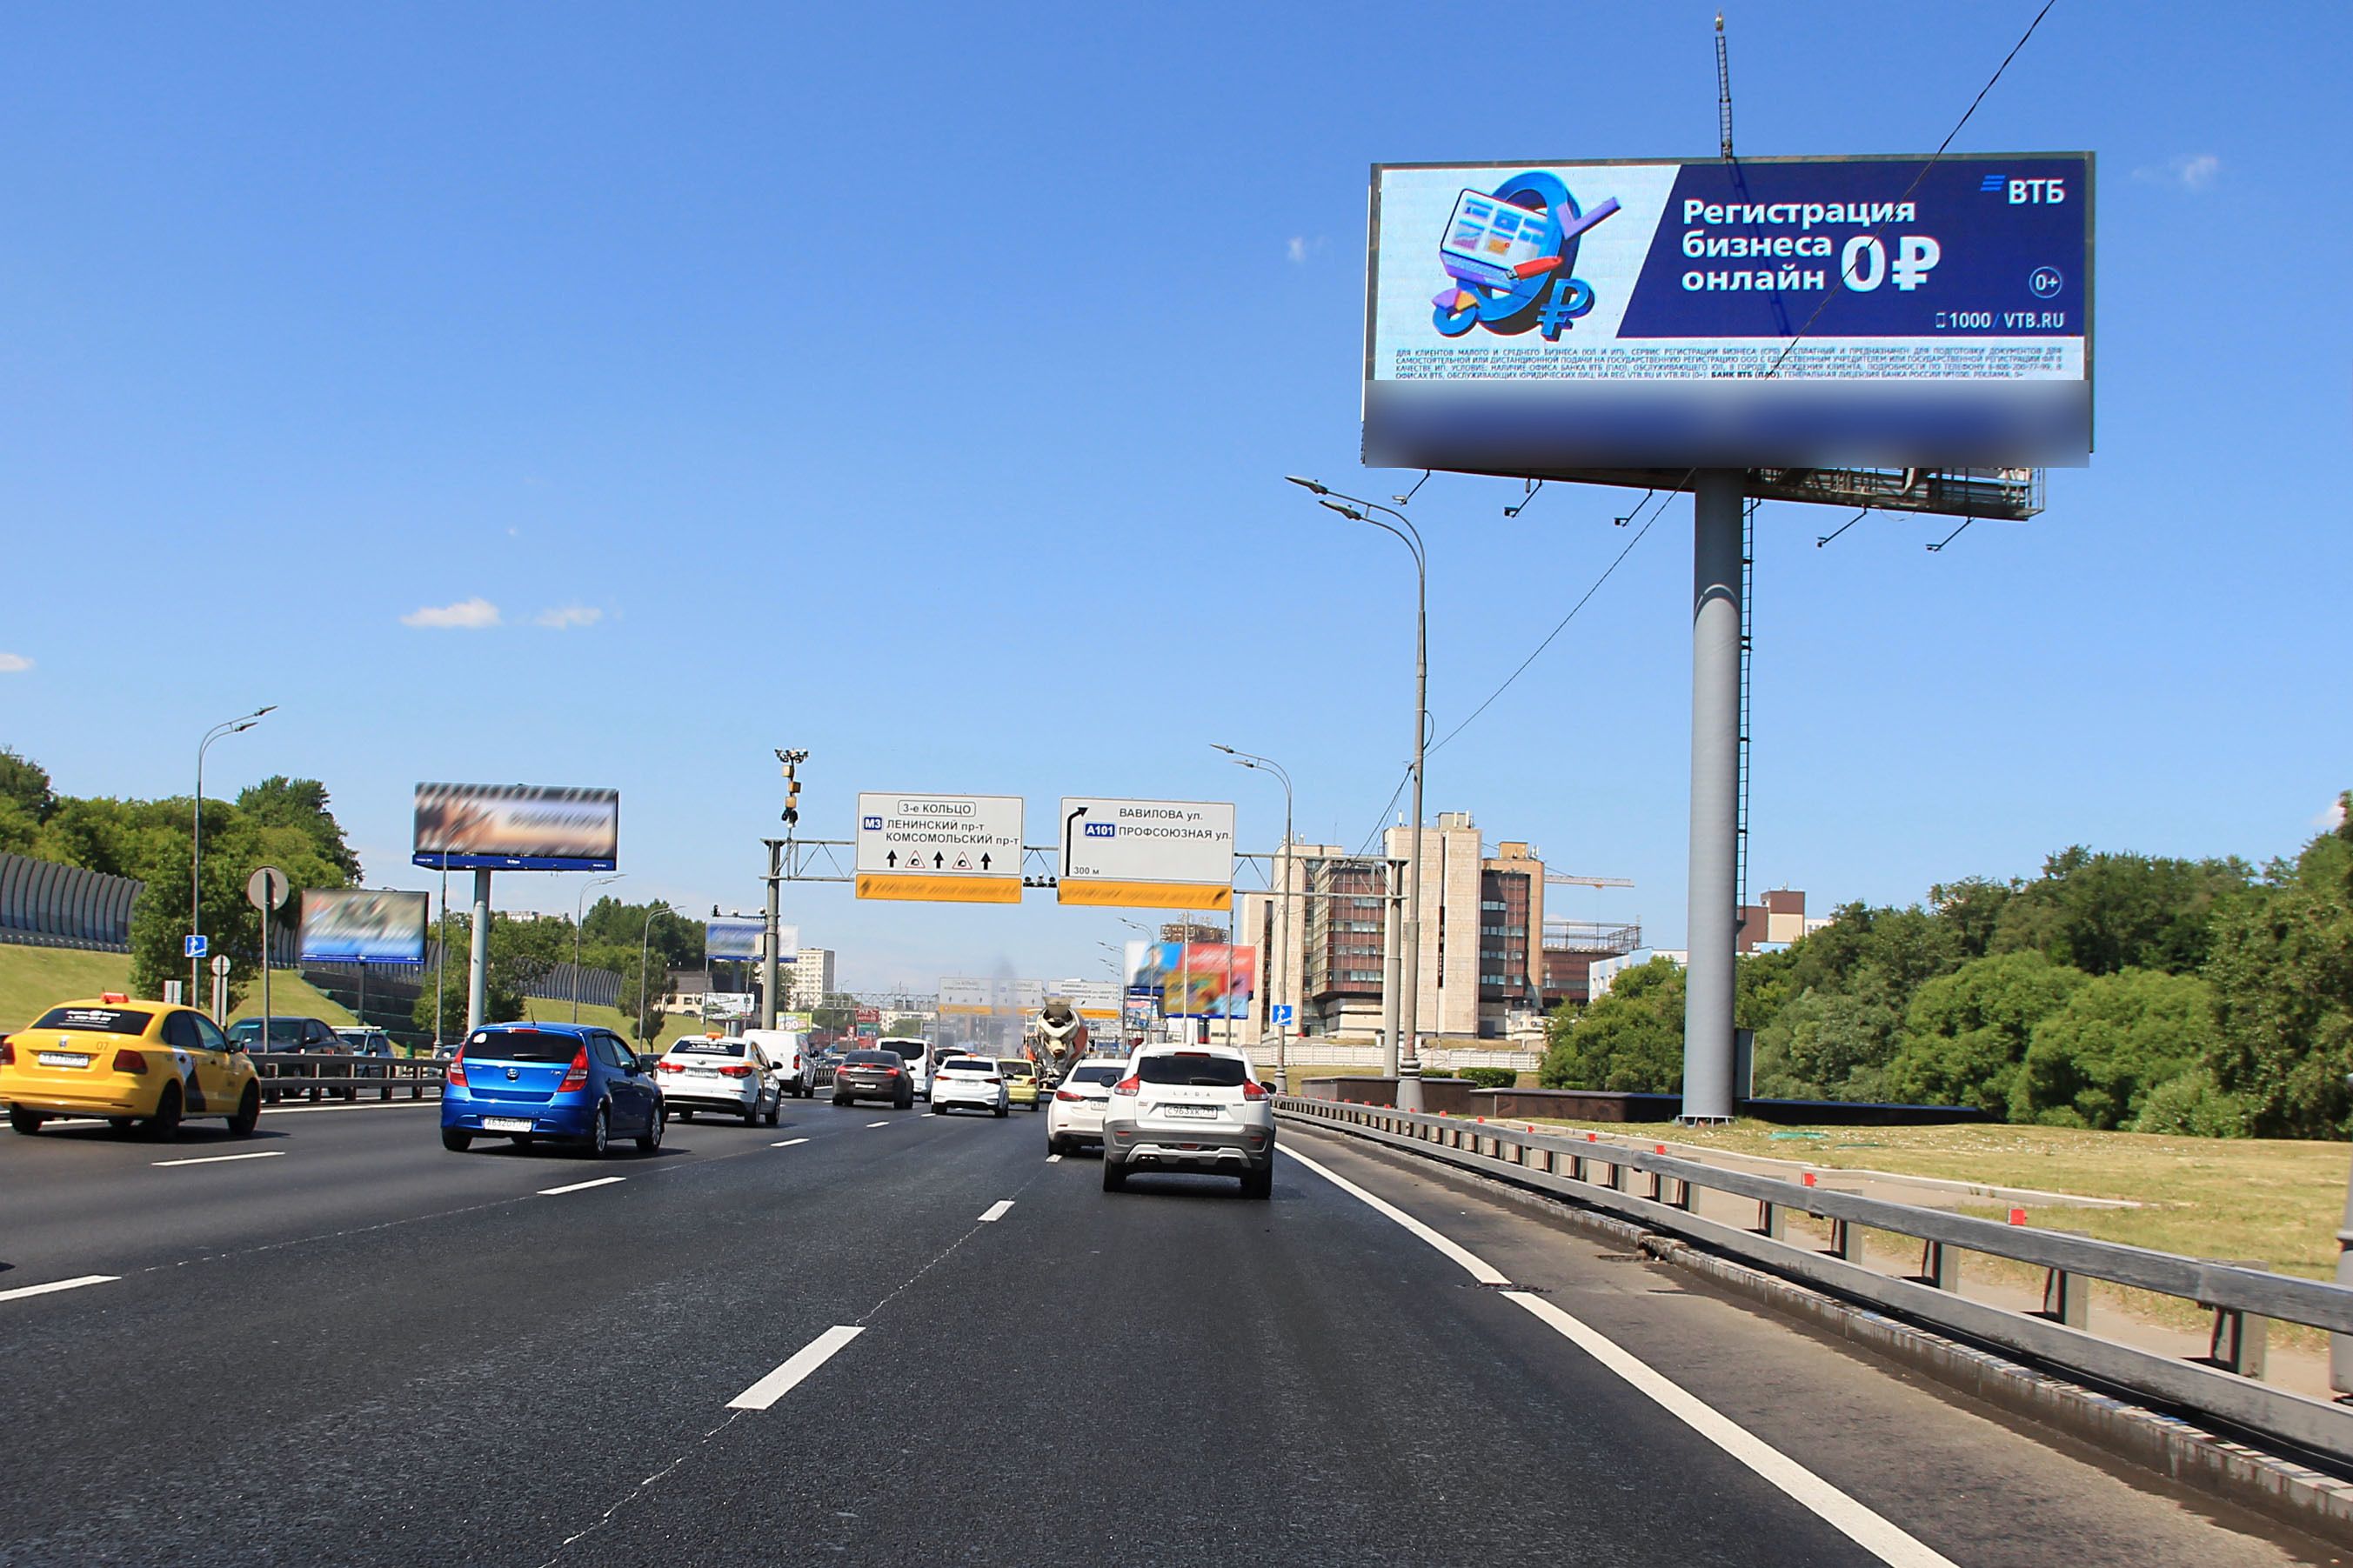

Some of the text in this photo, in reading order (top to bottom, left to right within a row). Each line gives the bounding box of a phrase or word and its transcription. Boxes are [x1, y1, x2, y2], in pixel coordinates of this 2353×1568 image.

[2009, 179, 2066, 204] ВТБ
[1683, 199, 1916, 230] Регистрация
[1682, 230, 1832, 257] бизнеса
[1681, 264, 1825, 291] онлайн
[2035, 274, 2059, 290] 0+
[1949, 312, 1991, 329] 1000
[2003, 312, 2065, 329] VTB.RU
[903, 804, 971, 815] 3-е КОЛЬЦО
[1119, 808, 1204, 822] ВАВИЛОВА ул.
[865, 818, 985, 832] М3 ЛЕНИНСКИЙ пр-т
[1086, 825, 1232, 841] А101 ПРОФСОЮЗНАЯ ул.
[886, 832, 1019, 846] КОМСОМОЛЬСКИЙ пр-т
[1073, 866, 1090, 875] 300
